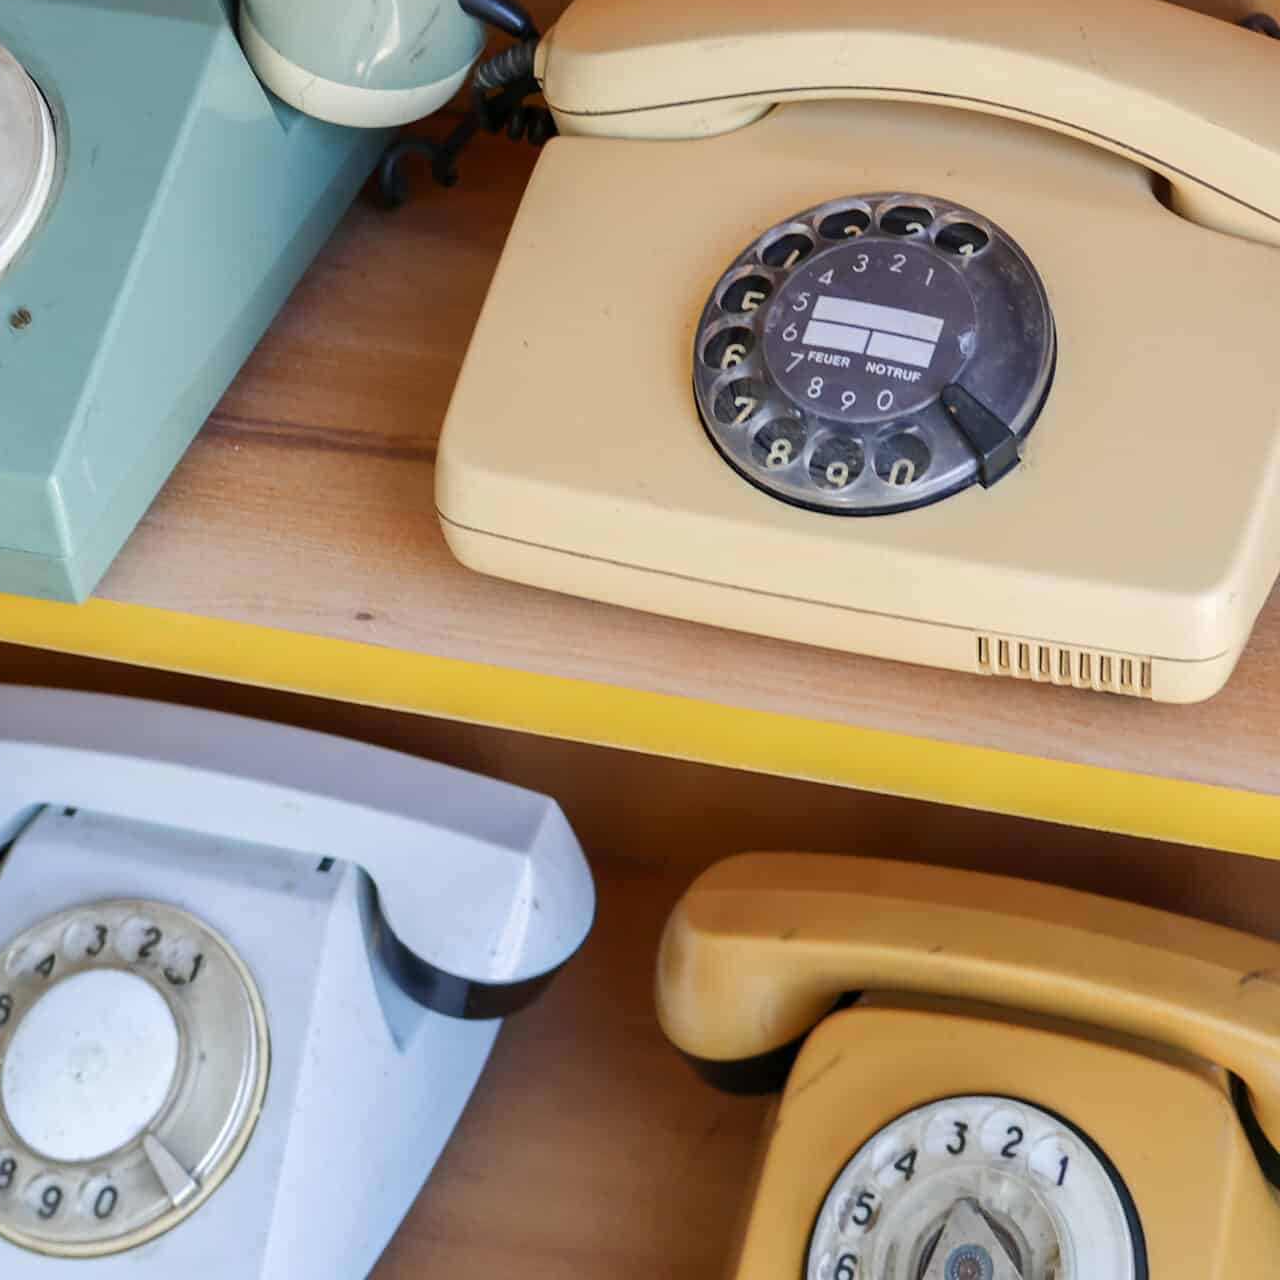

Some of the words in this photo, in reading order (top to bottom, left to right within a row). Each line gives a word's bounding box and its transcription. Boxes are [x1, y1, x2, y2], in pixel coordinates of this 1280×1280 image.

[817, 268, 835, 286] 4
[852, 253, 870, 273] 3
[889, 253, 907, 273] 2
[924, 267, 935, 287] 1
[792, 291, 811, 312] 5
[782, 323, 798, 342] 6
[785, 352, 805, 373] 7
[807, 350, 851, 368] FEUER
[865, 361, 922, 383] NOTRUF
[807, 376, 824, 398] 8
[840, 391, 857, 412] 9
[876, 389, 894, 411] 0
[721, 343, 747, 369] 6
[734, 396, 756, 425] 7
[766, 438, 793, 465] 8
[825, 461, 849, 487] 9
[888, 458, 916, 486] 0
[85, 924, 108, 956] 3
[138, 926, 162, 958] 2
[34, 953, 56, 979] 4
[189, 953, 204, 984] 1
[945, 1121, 969, 1155] 3
[1000, 1126, 1024, 1159] 2
[894, 1148, 918, 1182] 4
[1056, 1155, 1069, 1187] 1
[37, 1185, 63, 1219] 9
[93, 1185, 118, 1219] 0
[851, 1192, 876, 1226] 5
[834, 1253, 859, 1280] 6
